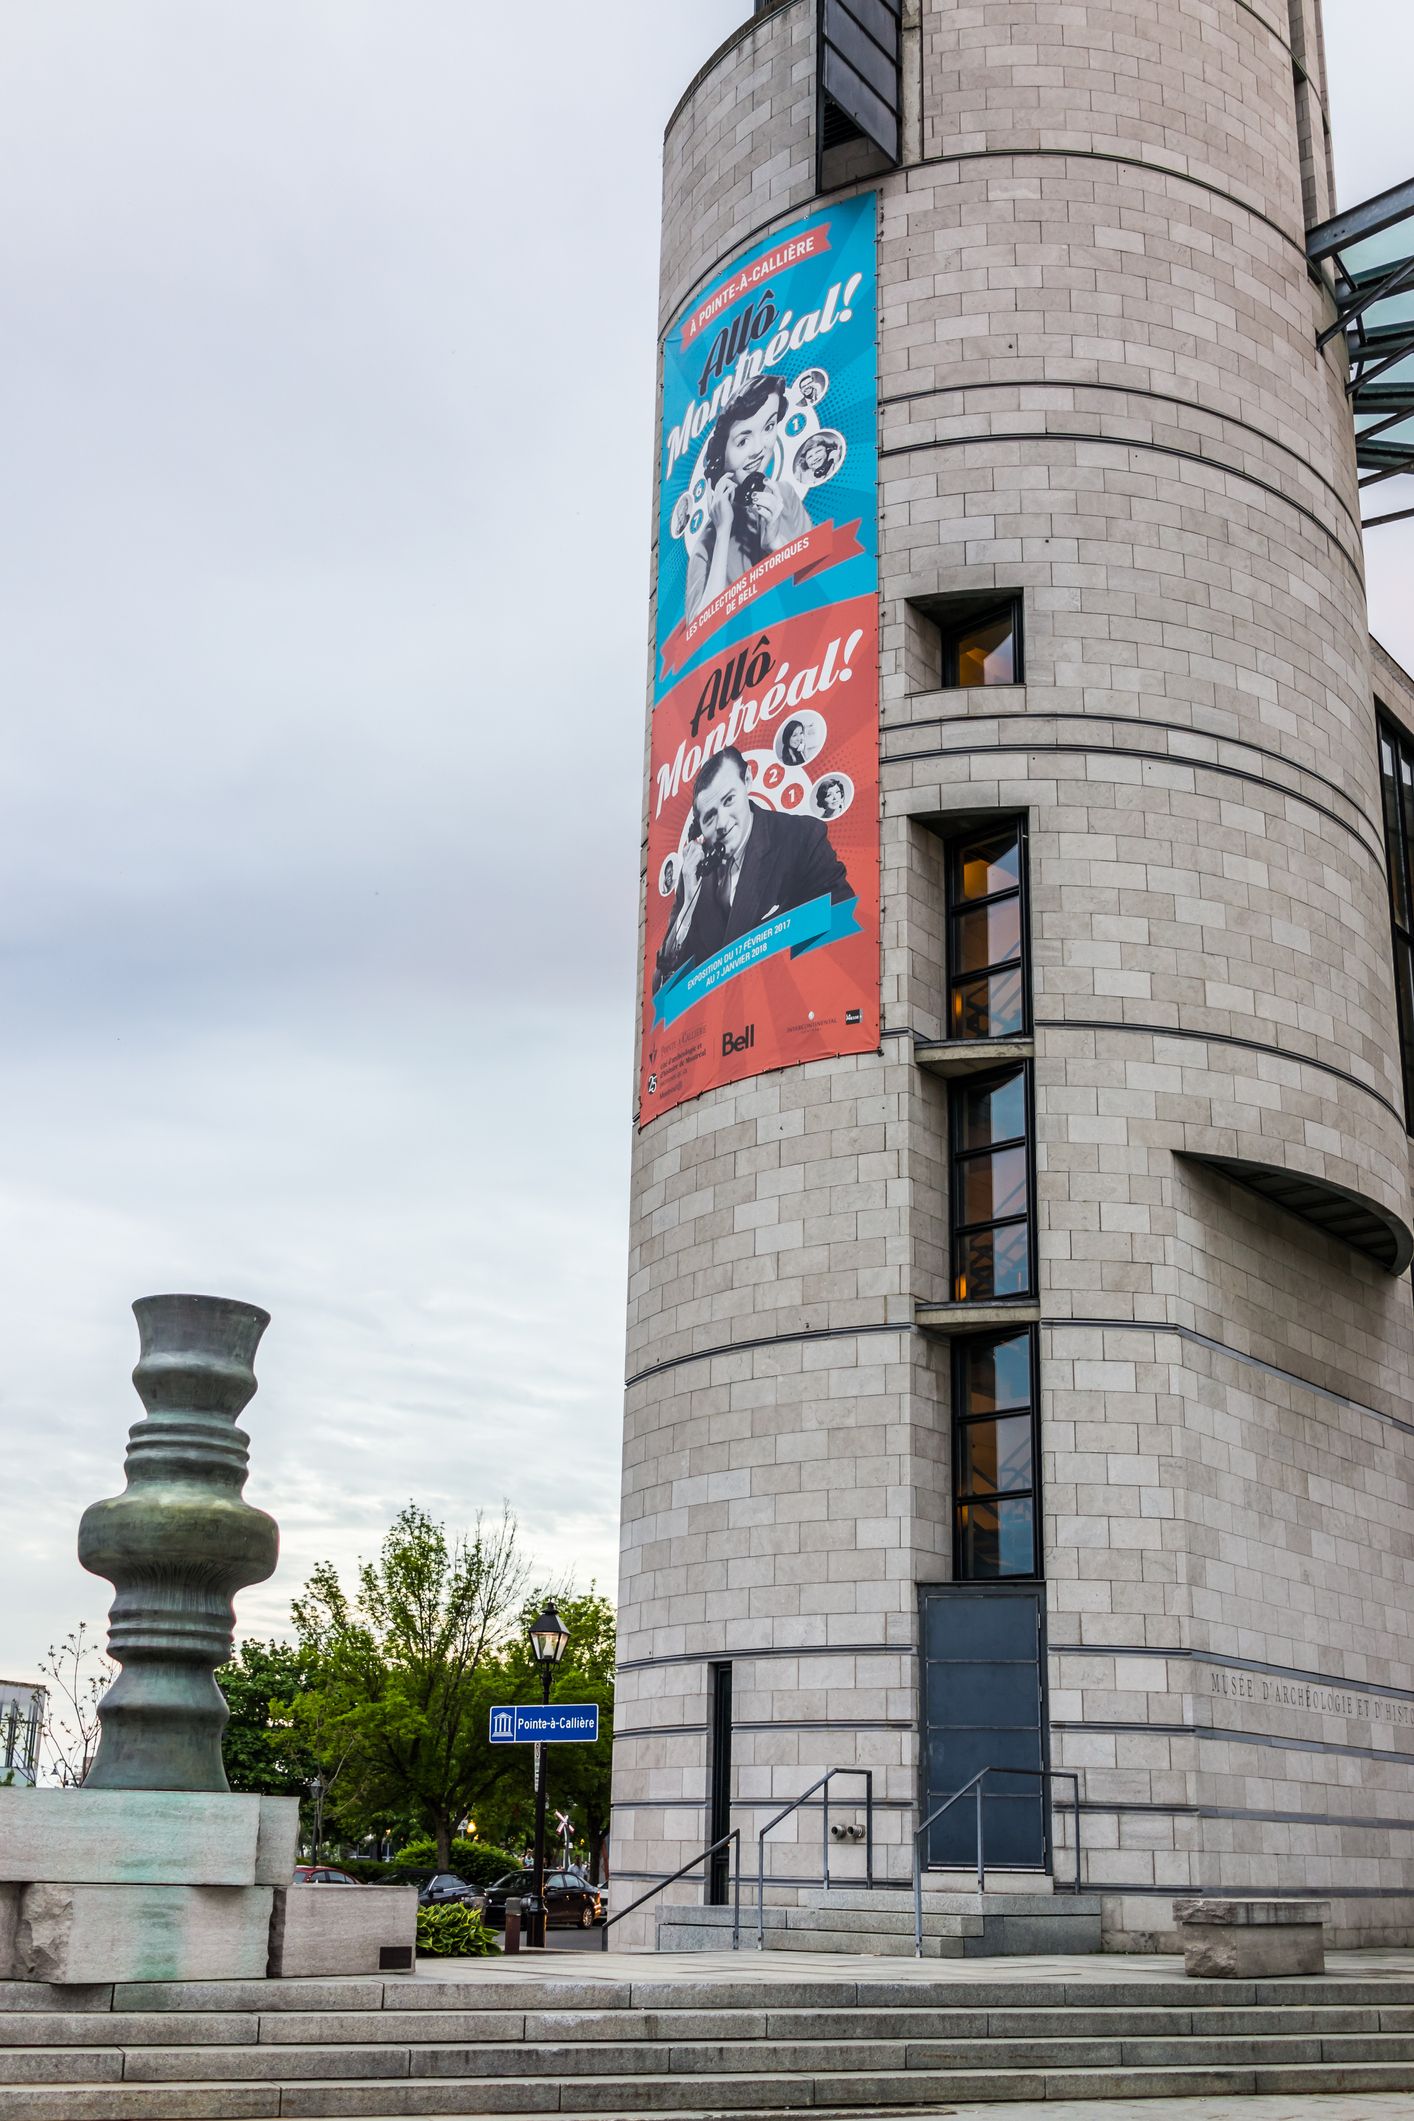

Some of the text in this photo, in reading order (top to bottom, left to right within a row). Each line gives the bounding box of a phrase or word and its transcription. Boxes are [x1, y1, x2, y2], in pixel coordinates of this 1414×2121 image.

[689, 236, 815, 337] À POINTE-À-CALLIÈRE
[666, 272, 863, 480] Montréal!
[698, 289, 780, 396] Allô
[686, 537, 810, 641] LES COLLECTIONS HISTORIQUES
[726, 584, 758, 615] DE BELL
[690, 635, 776, 738] Allô
[655, 628, 863, 821] Montréal!
[768, 768, 778, 784] 2
[687, 919, 791, 990] EXPOSITION DU 17 FÉVRIER 2017
[705, 976, 715, 988] AU
[721, 952, 751, 977] JANVIER
[751, 943, 768, 958] 2018
[721, 1023, 755, 1057] Bell
[517, 1716, 595, 1730] Pointe-à-Callière
[1211, 1673, 1253, 1697] MUSÉE
[1262, 1681, 1352, 1714] D'ARCHÉOLOGIE
[1357, 1698, 1369, 1717] ET
